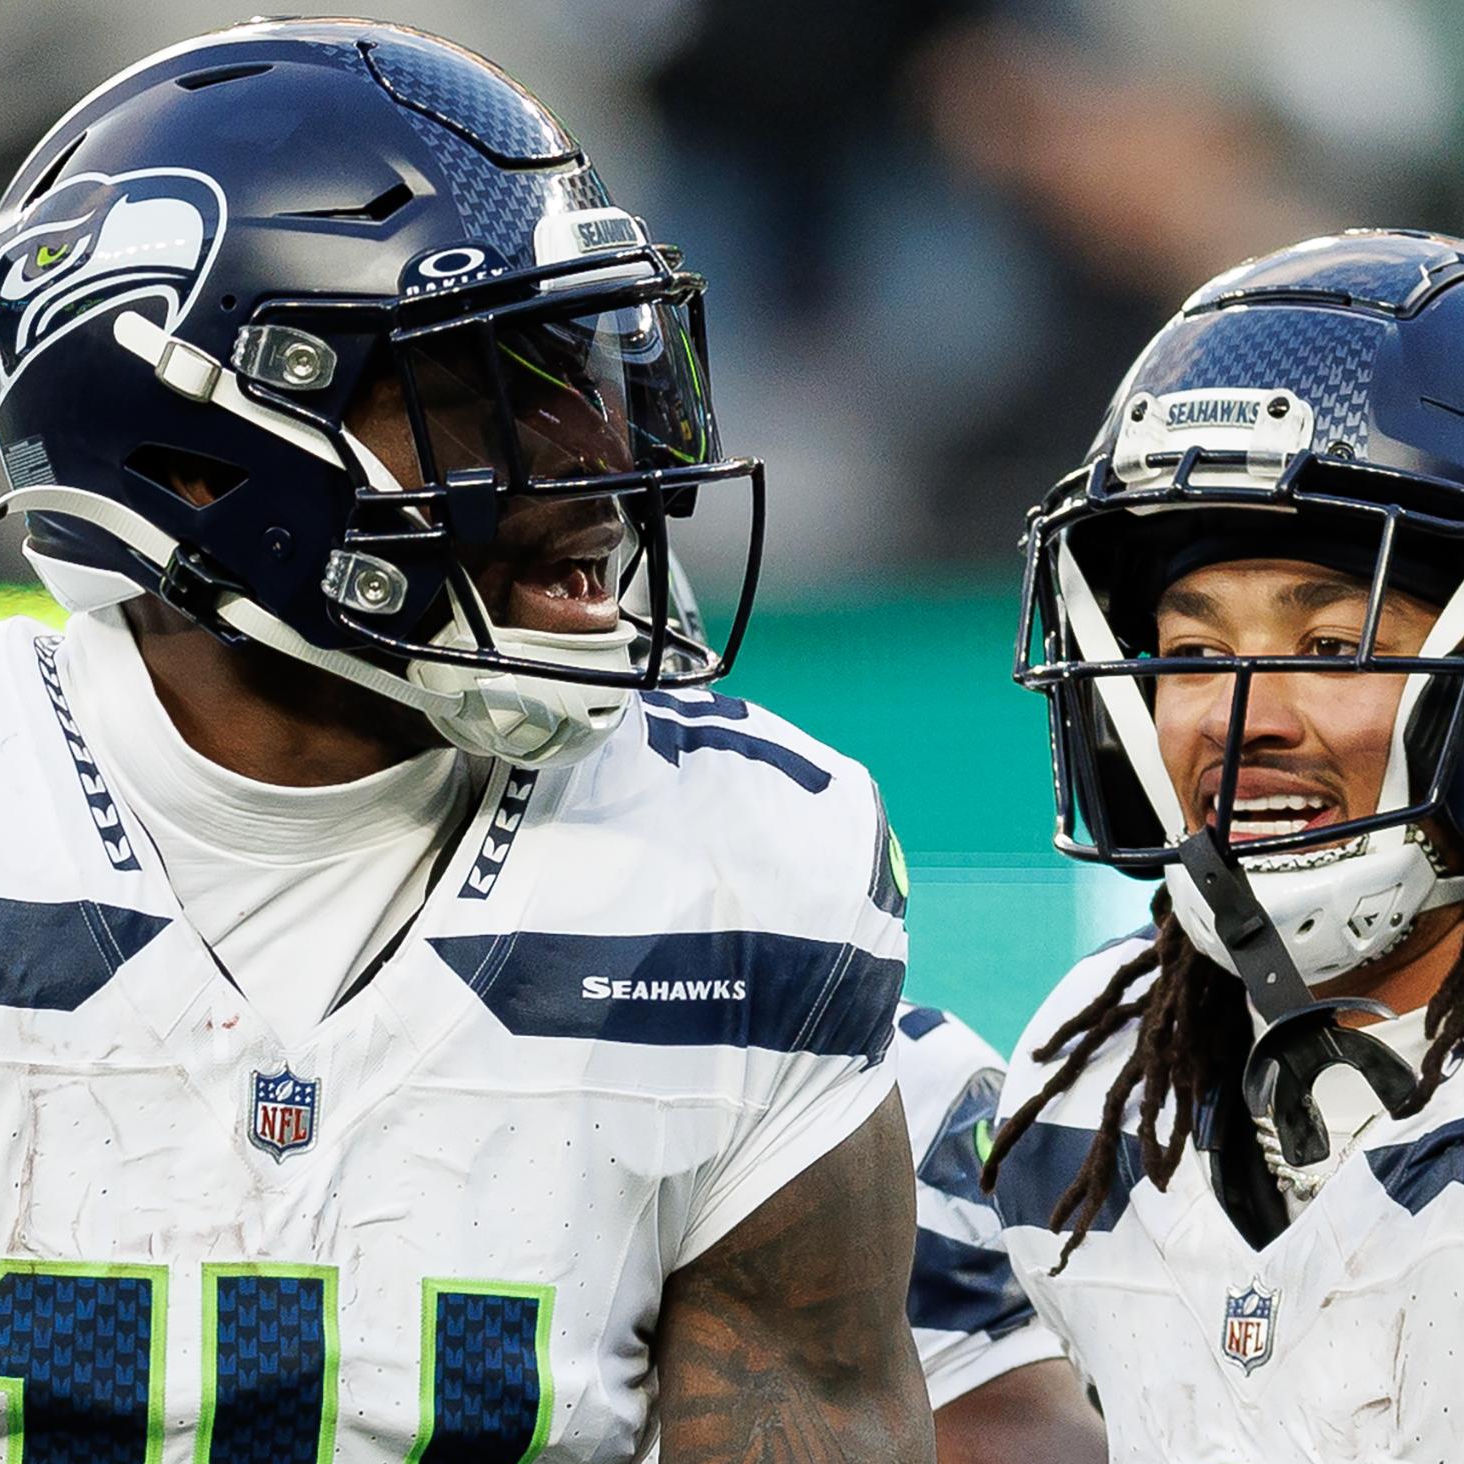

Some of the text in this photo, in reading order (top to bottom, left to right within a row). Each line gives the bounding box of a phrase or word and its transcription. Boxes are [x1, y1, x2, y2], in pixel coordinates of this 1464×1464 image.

[1166, 400, 1261, 426] SEAHAWKS
[582, 975, 747, 1001] SEAHAWKS
[259, 1104, 309, 1146] NFL
[1227, 1320, 1264, 1357] NFL
